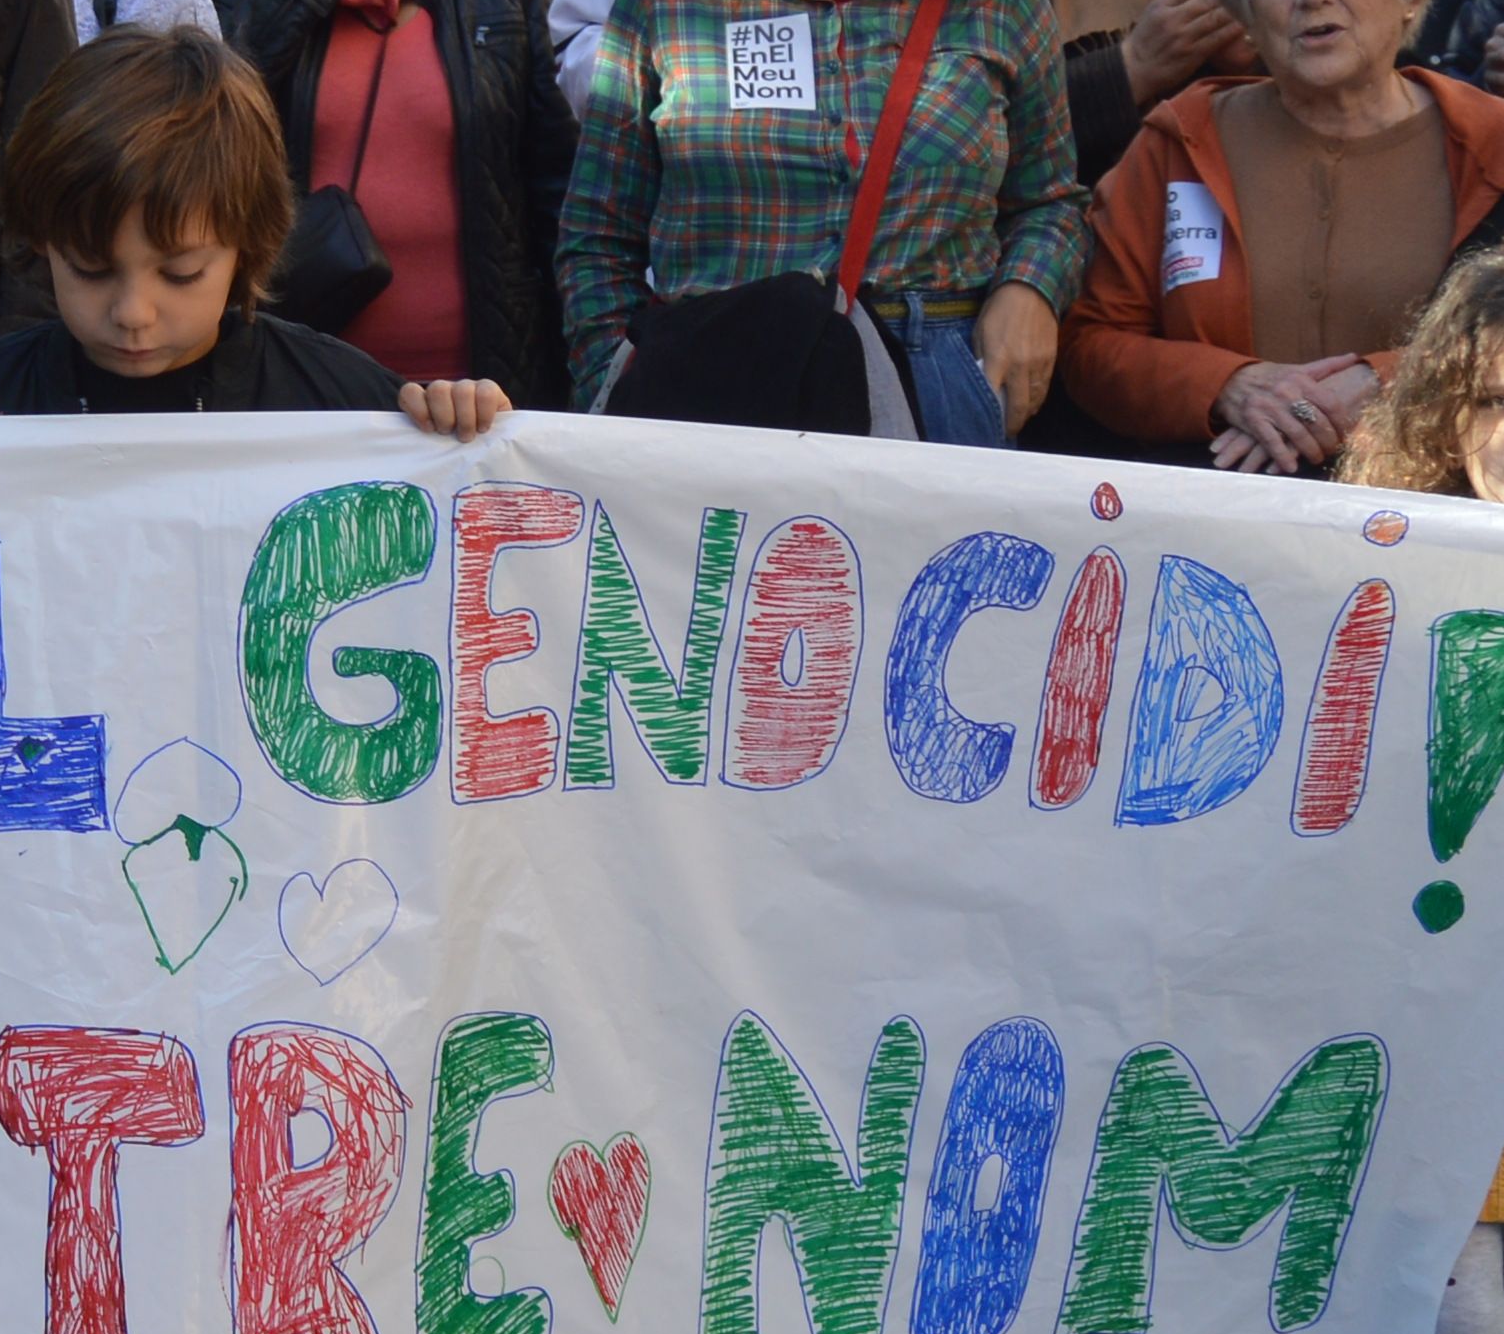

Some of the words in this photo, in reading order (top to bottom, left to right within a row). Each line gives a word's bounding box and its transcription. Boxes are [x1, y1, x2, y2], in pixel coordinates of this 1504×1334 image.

[731, 22, 795, 47] #No
[732, 43, 794, 64] EnEl
[733, 65, 796, 82] Meu
[734, 82, 804, 99] Nom
[1167, 191, 1178, 204] o
